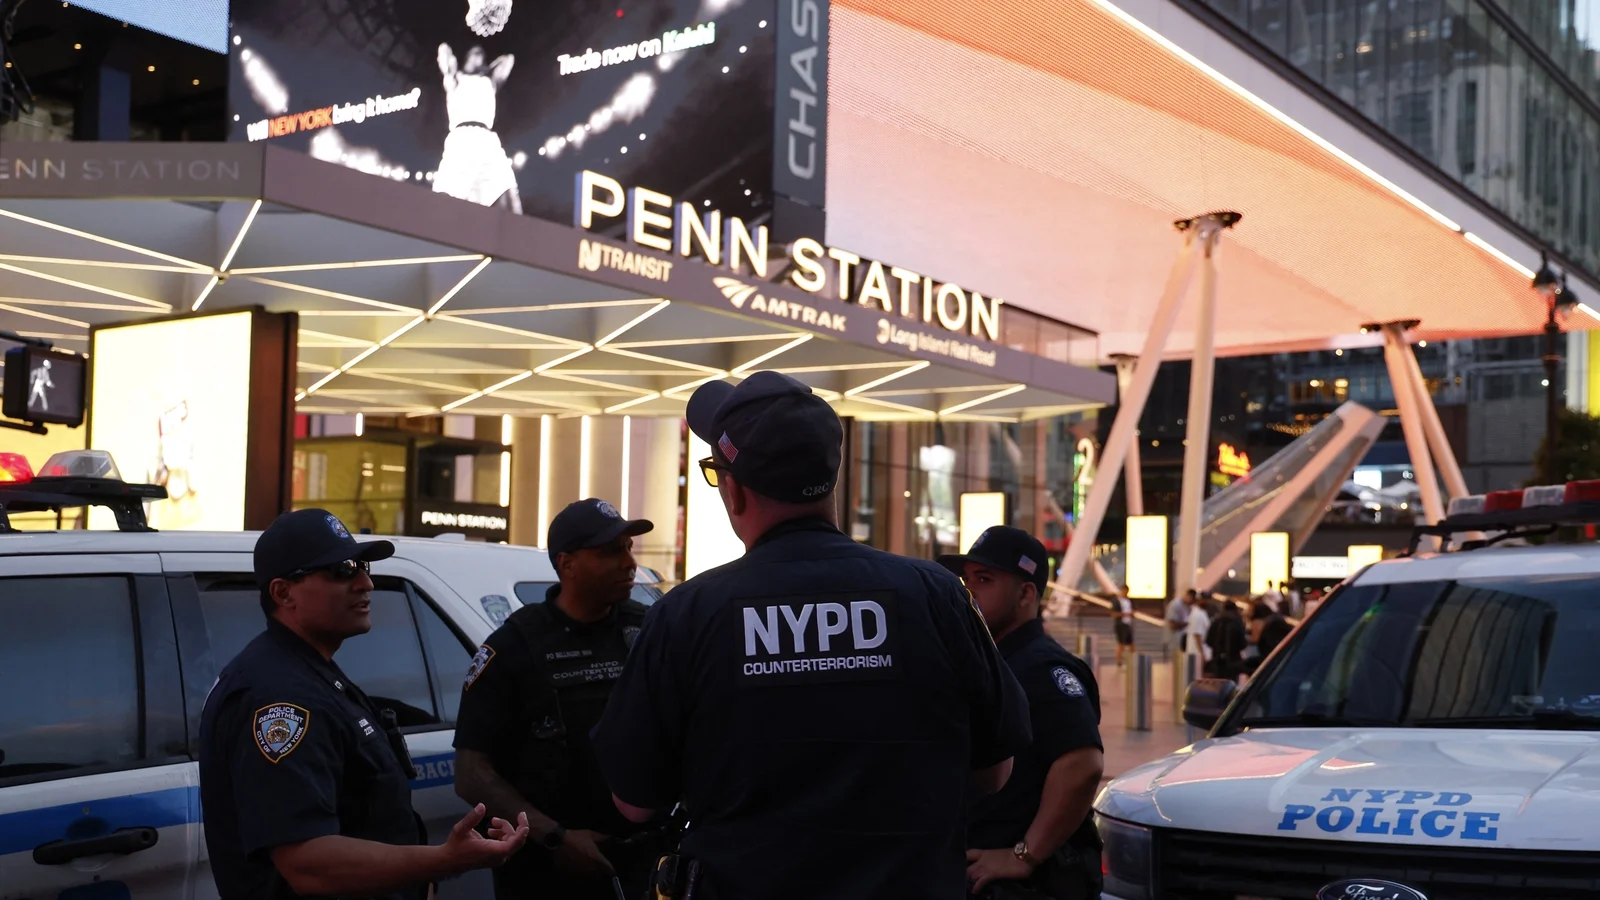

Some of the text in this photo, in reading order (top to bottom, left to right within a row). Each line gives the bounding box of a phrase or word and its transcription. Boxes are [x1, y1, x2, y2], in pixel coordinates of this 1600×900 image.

[557, 47, 601, 76] Trade
[602, 43, 639, 66] now
[638, 38, 661, 58] on
[788, 0, 819, 180] CHAS
[247, 87, 421, 142] Will NEW YORK bring it home?
[82, 158, 240, 181] STATION
[576, 168, 1000, 341] PENN STATION
[601, 246, 674, 283] TRANSIT
[750, 294, 847, 332] AMTRAK
[890, 323, 918, 352] Long
[918, 331, 950, 356] Island
[970, 344, 996, 367] Road
[421, 511, 507, 530] PENN STATION
[743, 600, 888, 656] NYPD
[590, 660, 619, 669] NYPD
[743, 654, 893, 676] COUNTERTERRORISM
[258, 712, 304, 723] DEPARTMENT
[269, 706, 296, 714] POLICE
[256, 730, 271, 753] CITY OF
[279, 726, 304, 754] NEW YORK
[1320, 788, 1473, 806] NYPD
[1277, 804, 1500, 841] POLICE
